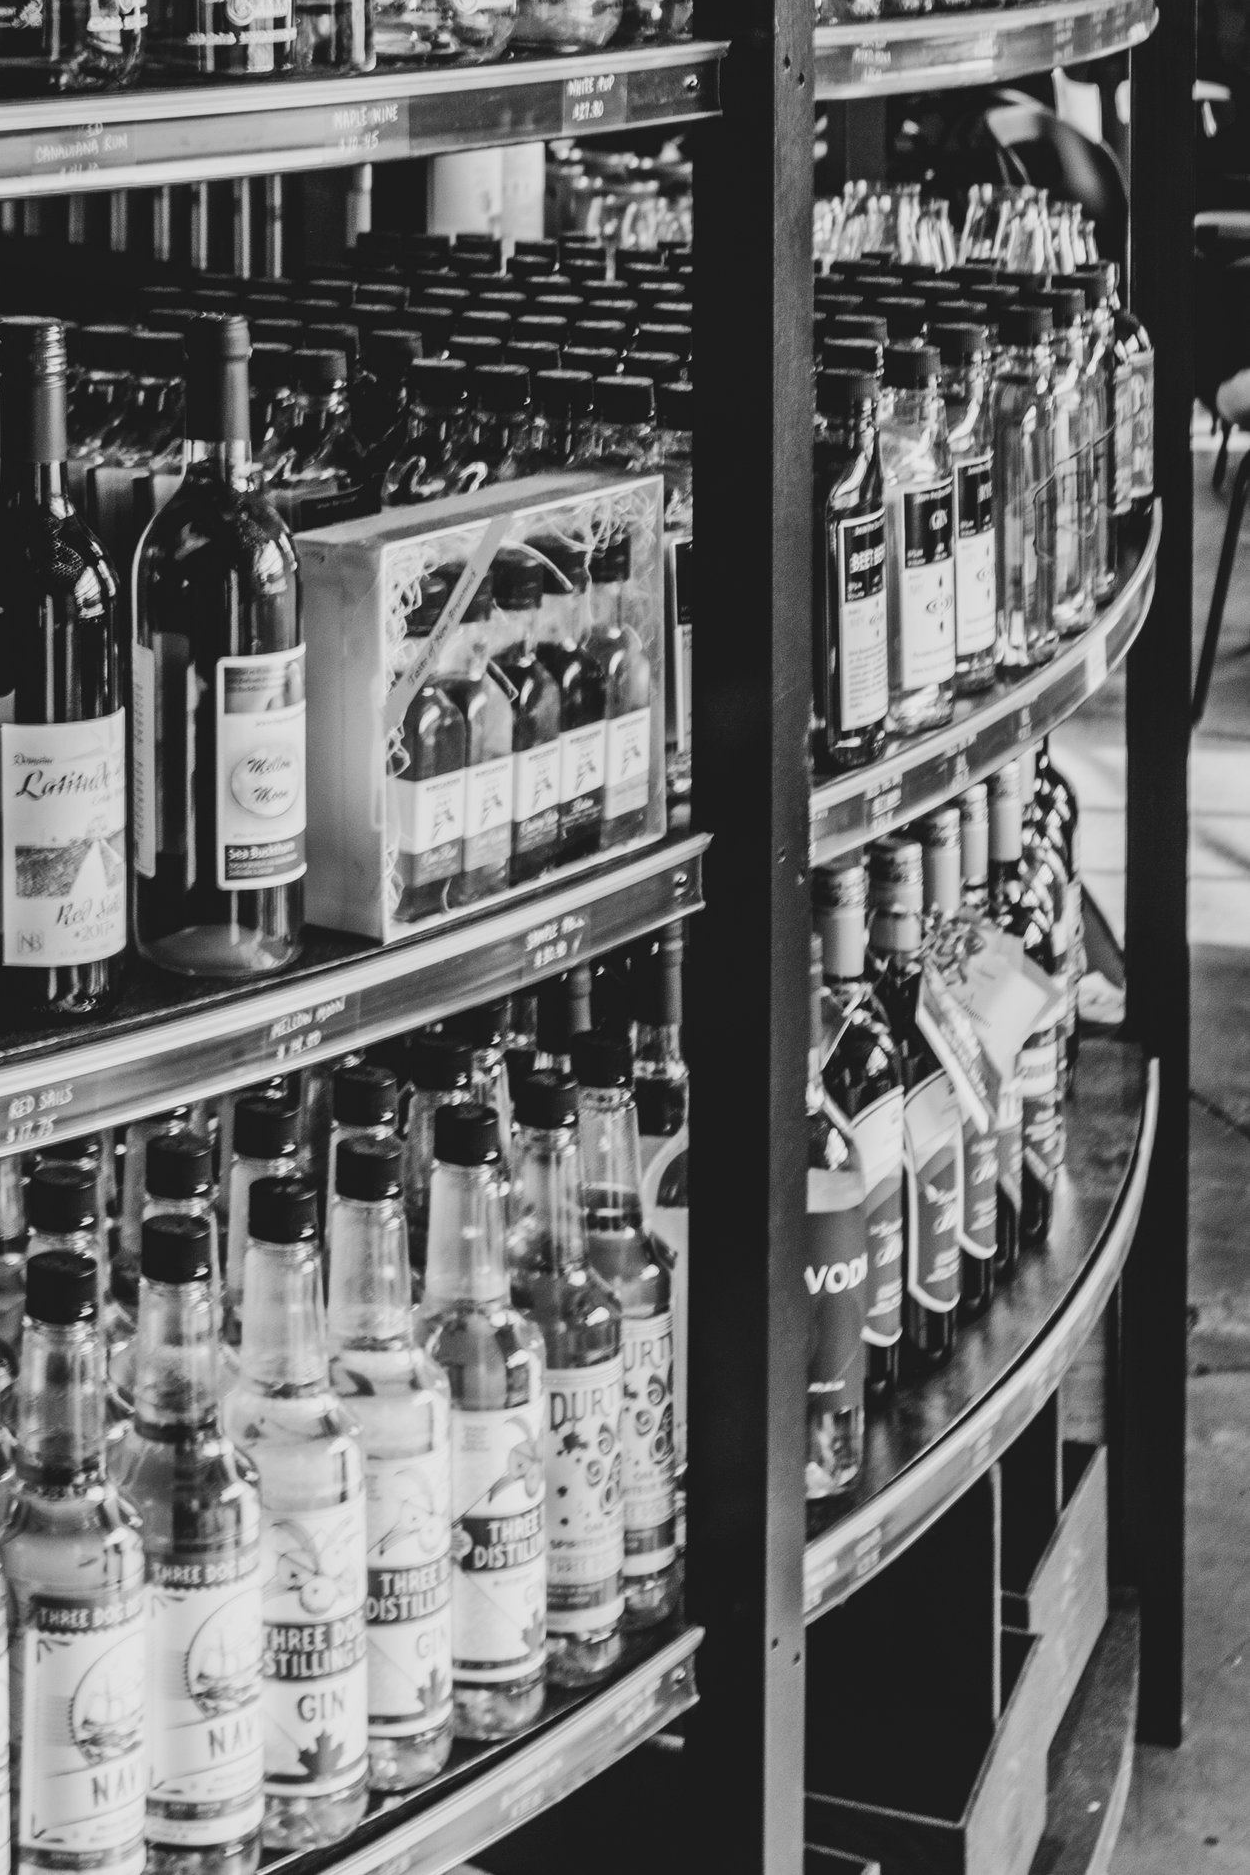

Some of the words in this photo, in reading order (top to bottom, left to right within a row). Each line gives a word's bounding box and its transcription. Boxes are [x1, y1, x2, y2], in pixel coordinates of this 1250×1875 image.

[333, 107, 368, 129] MAPLE
[372, 102, 399, 125] WINE
[35, 137, 100, 164] CANADIANA
[102, 132, 129, 152] RUM
[247, 754, 293, 776] Mellow
[56, 896, 93, 929] Red
[8, 1096, 36, 1121] RED
[37, 1084, 74, 1115] SAILS
[151, 1562, 201, 1584] THREE
[39, 1607, 91, 1627] THREE
[297, 1689, 348, 1724] GIN
